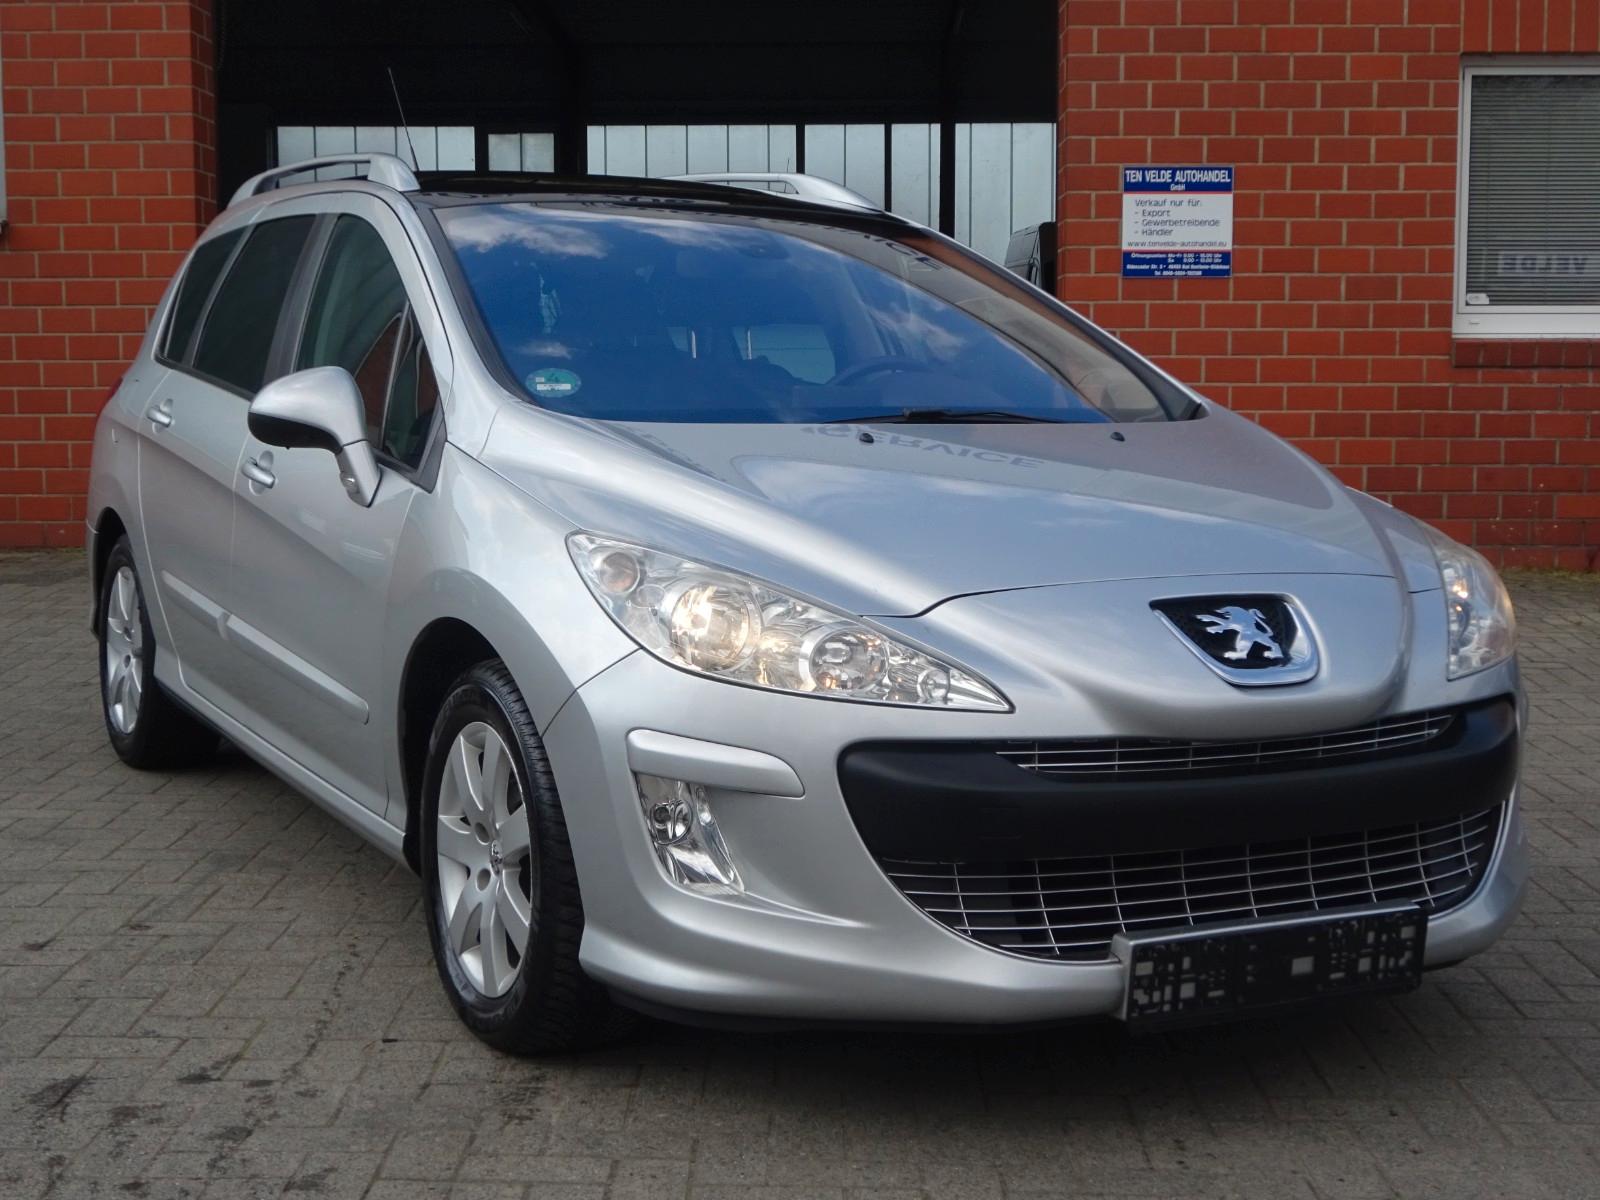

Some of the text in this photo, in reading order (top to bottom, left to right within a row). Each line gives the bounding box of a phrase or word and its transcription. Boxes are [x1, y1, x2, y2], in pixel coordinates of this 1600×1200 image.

[1125, 170, 1231, 183] TEN VELDE AUTOHANDEL
[1135, 198, 1167, 207] Verkauf
[1142, 209, 1171, 217] Export
[1142, 218, 1221, 227] Gewerbetreibende
[1142, 228, 1174, 236] Händler
